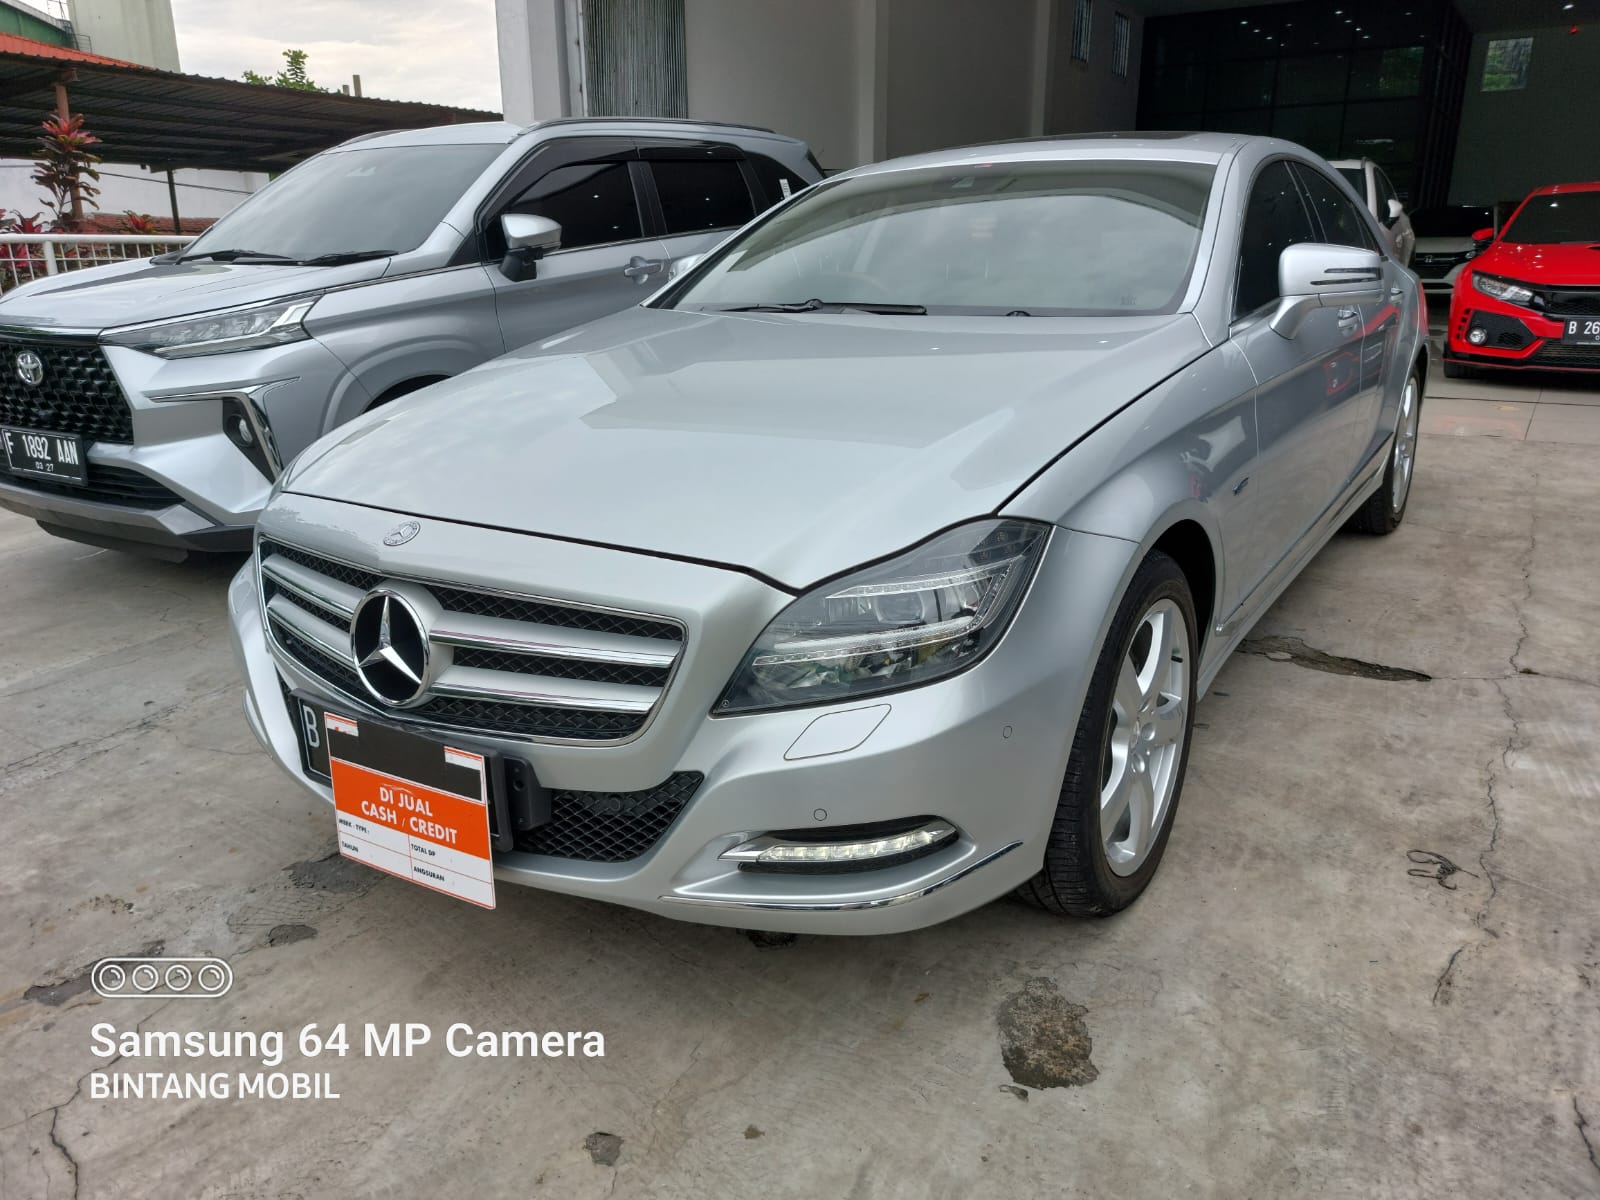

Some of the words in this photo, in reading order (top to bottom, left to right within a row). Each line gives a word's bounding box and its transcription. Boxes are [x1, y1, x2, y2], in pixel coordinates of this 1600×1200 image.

[1568, 321, 1577, 334] B
[5, 432, 14, 454] F
[22, 435, 52, 460] 1892
[56, 439, 79, 465] AAN
[46, 463, 54, 472] 27
[302, 704, 320, 748] B
[379, 786, 394, 805] DI
[398, 793, 433, 817] JUAL
[361, 800, 398, 825] CASH
[409, 816, 458, 845] CREDIT
[411, 843, 428, 855] TOTAL
